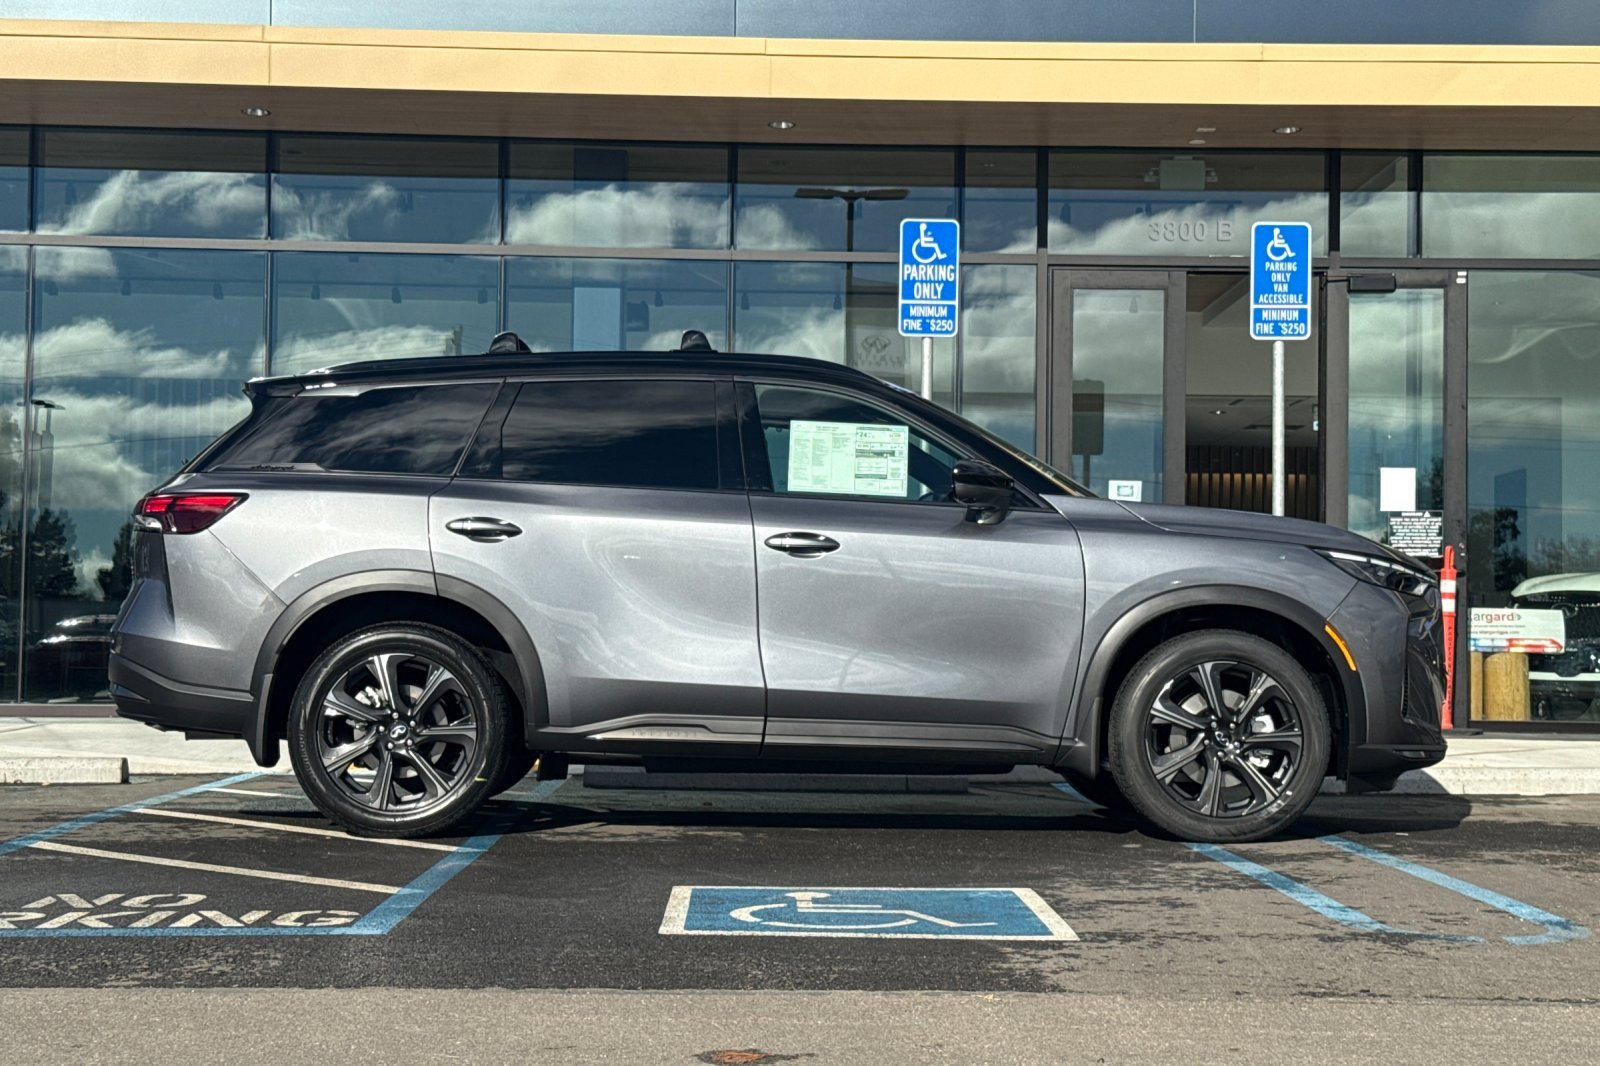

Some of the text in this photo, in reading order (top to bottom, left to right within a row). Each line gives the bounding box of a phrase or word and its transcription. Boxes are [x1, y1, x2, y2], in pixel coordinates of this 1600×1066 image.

[1148, 221, 1207, 242] 3800
[903, 264, 955, 281] PARKING
[1265, 261, 1297, 271] PARKING
[1271, 272, 1291, 282] ONLY
[913, 282, 945, 299] ONLY
[1273, 283, 1288, 292] VAN
[1258, 293, 1304, 304] ACCESSIBLE
[909, 305, 948, 318] MINIMUM
[1262, 309, 1300, 321] MINIMUM
[903, 319, 954, 332] FINE $250
[1255, 322, 1306, 335] FINE $250
[1470, 612, 1515, 624] argard
[21, 893, 208, 910] NO
